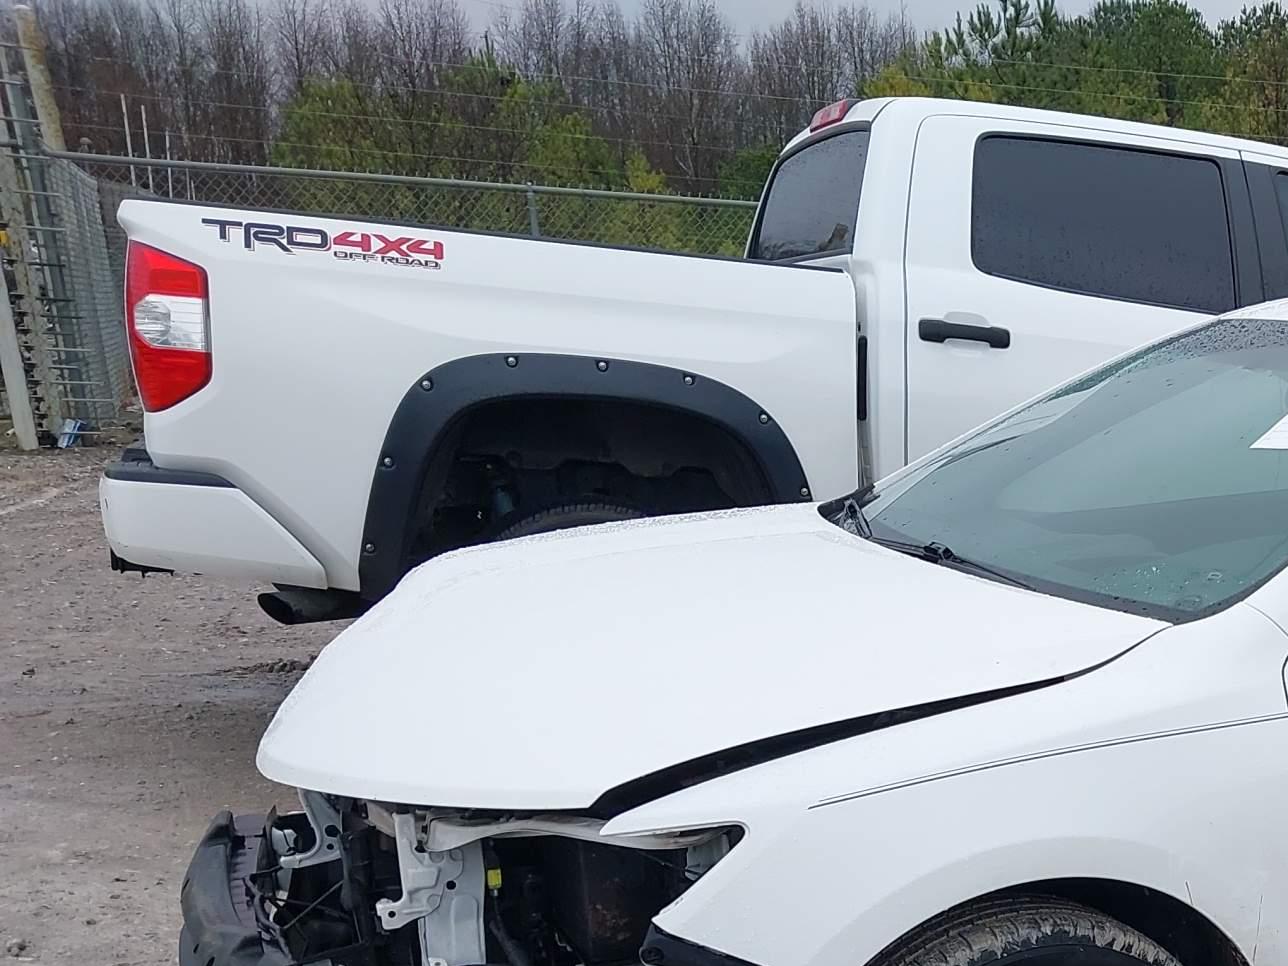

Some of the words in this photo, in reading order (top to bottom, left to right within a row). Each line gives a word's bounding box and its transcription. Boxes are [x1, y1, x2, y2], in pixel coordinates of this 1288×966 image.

[201, 218, 331, 255] TRD
[333, 250, 377, 262] OFF
[381, 255, 441, 269] ROAD
